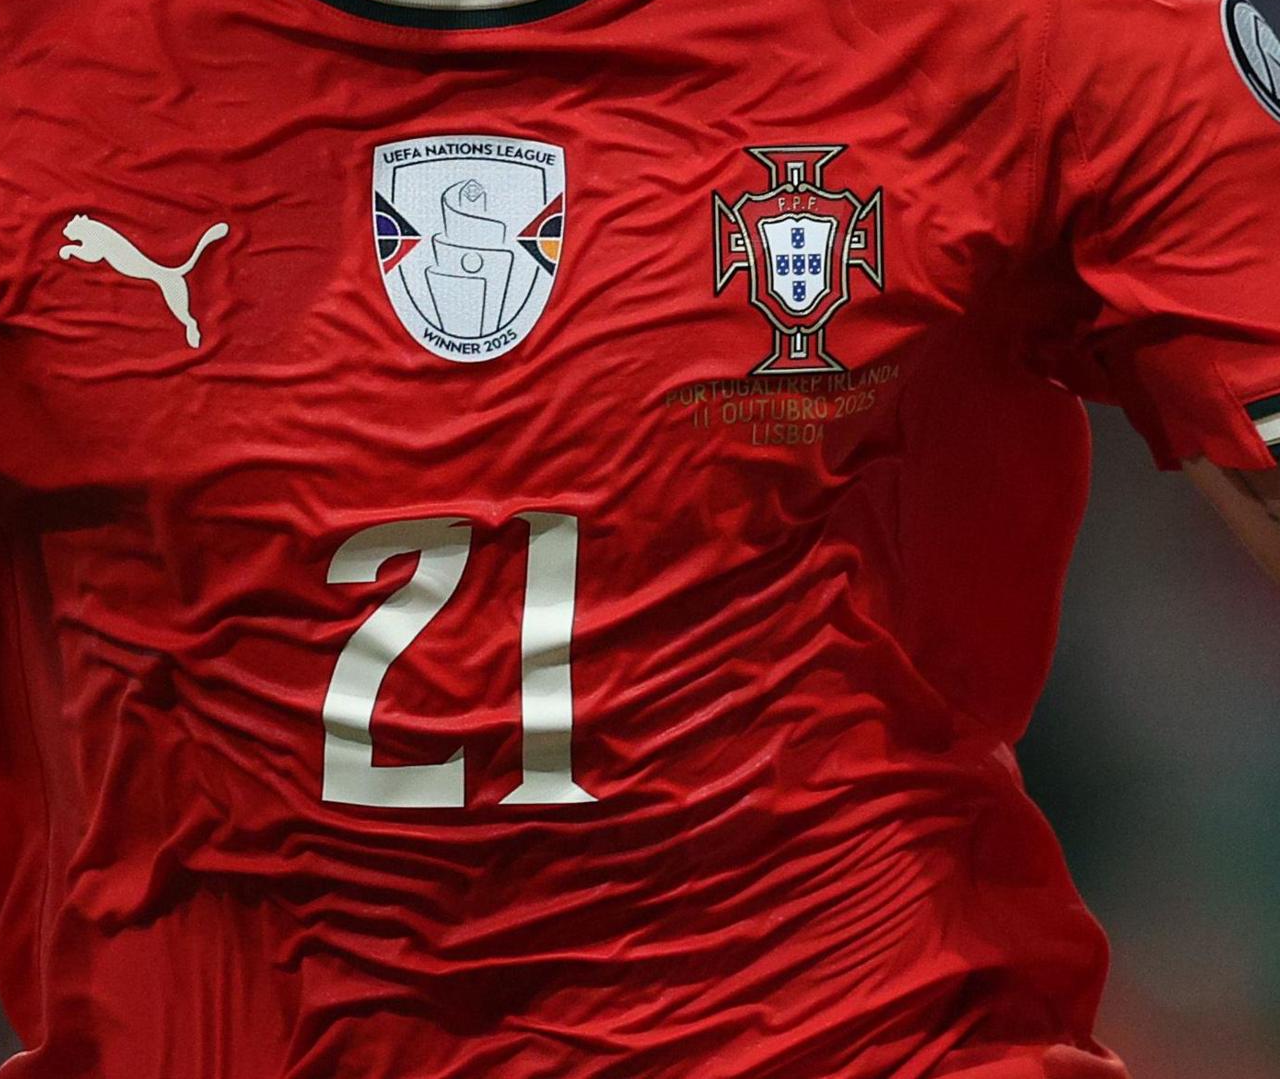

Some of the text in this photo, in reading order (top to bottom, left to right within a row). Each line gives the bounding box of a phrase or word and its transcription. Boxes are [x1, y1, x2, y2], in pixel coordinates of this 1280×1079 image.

[383, 143, 556, 166] UEFA NATIONS LEAGUE
[423, 327, 518, 355] WINNER 2025
[722, 395, 828, 425] OUTUBRO
[834, 388, 875, 419] 2025
[321, 511, 599, 808] 21
